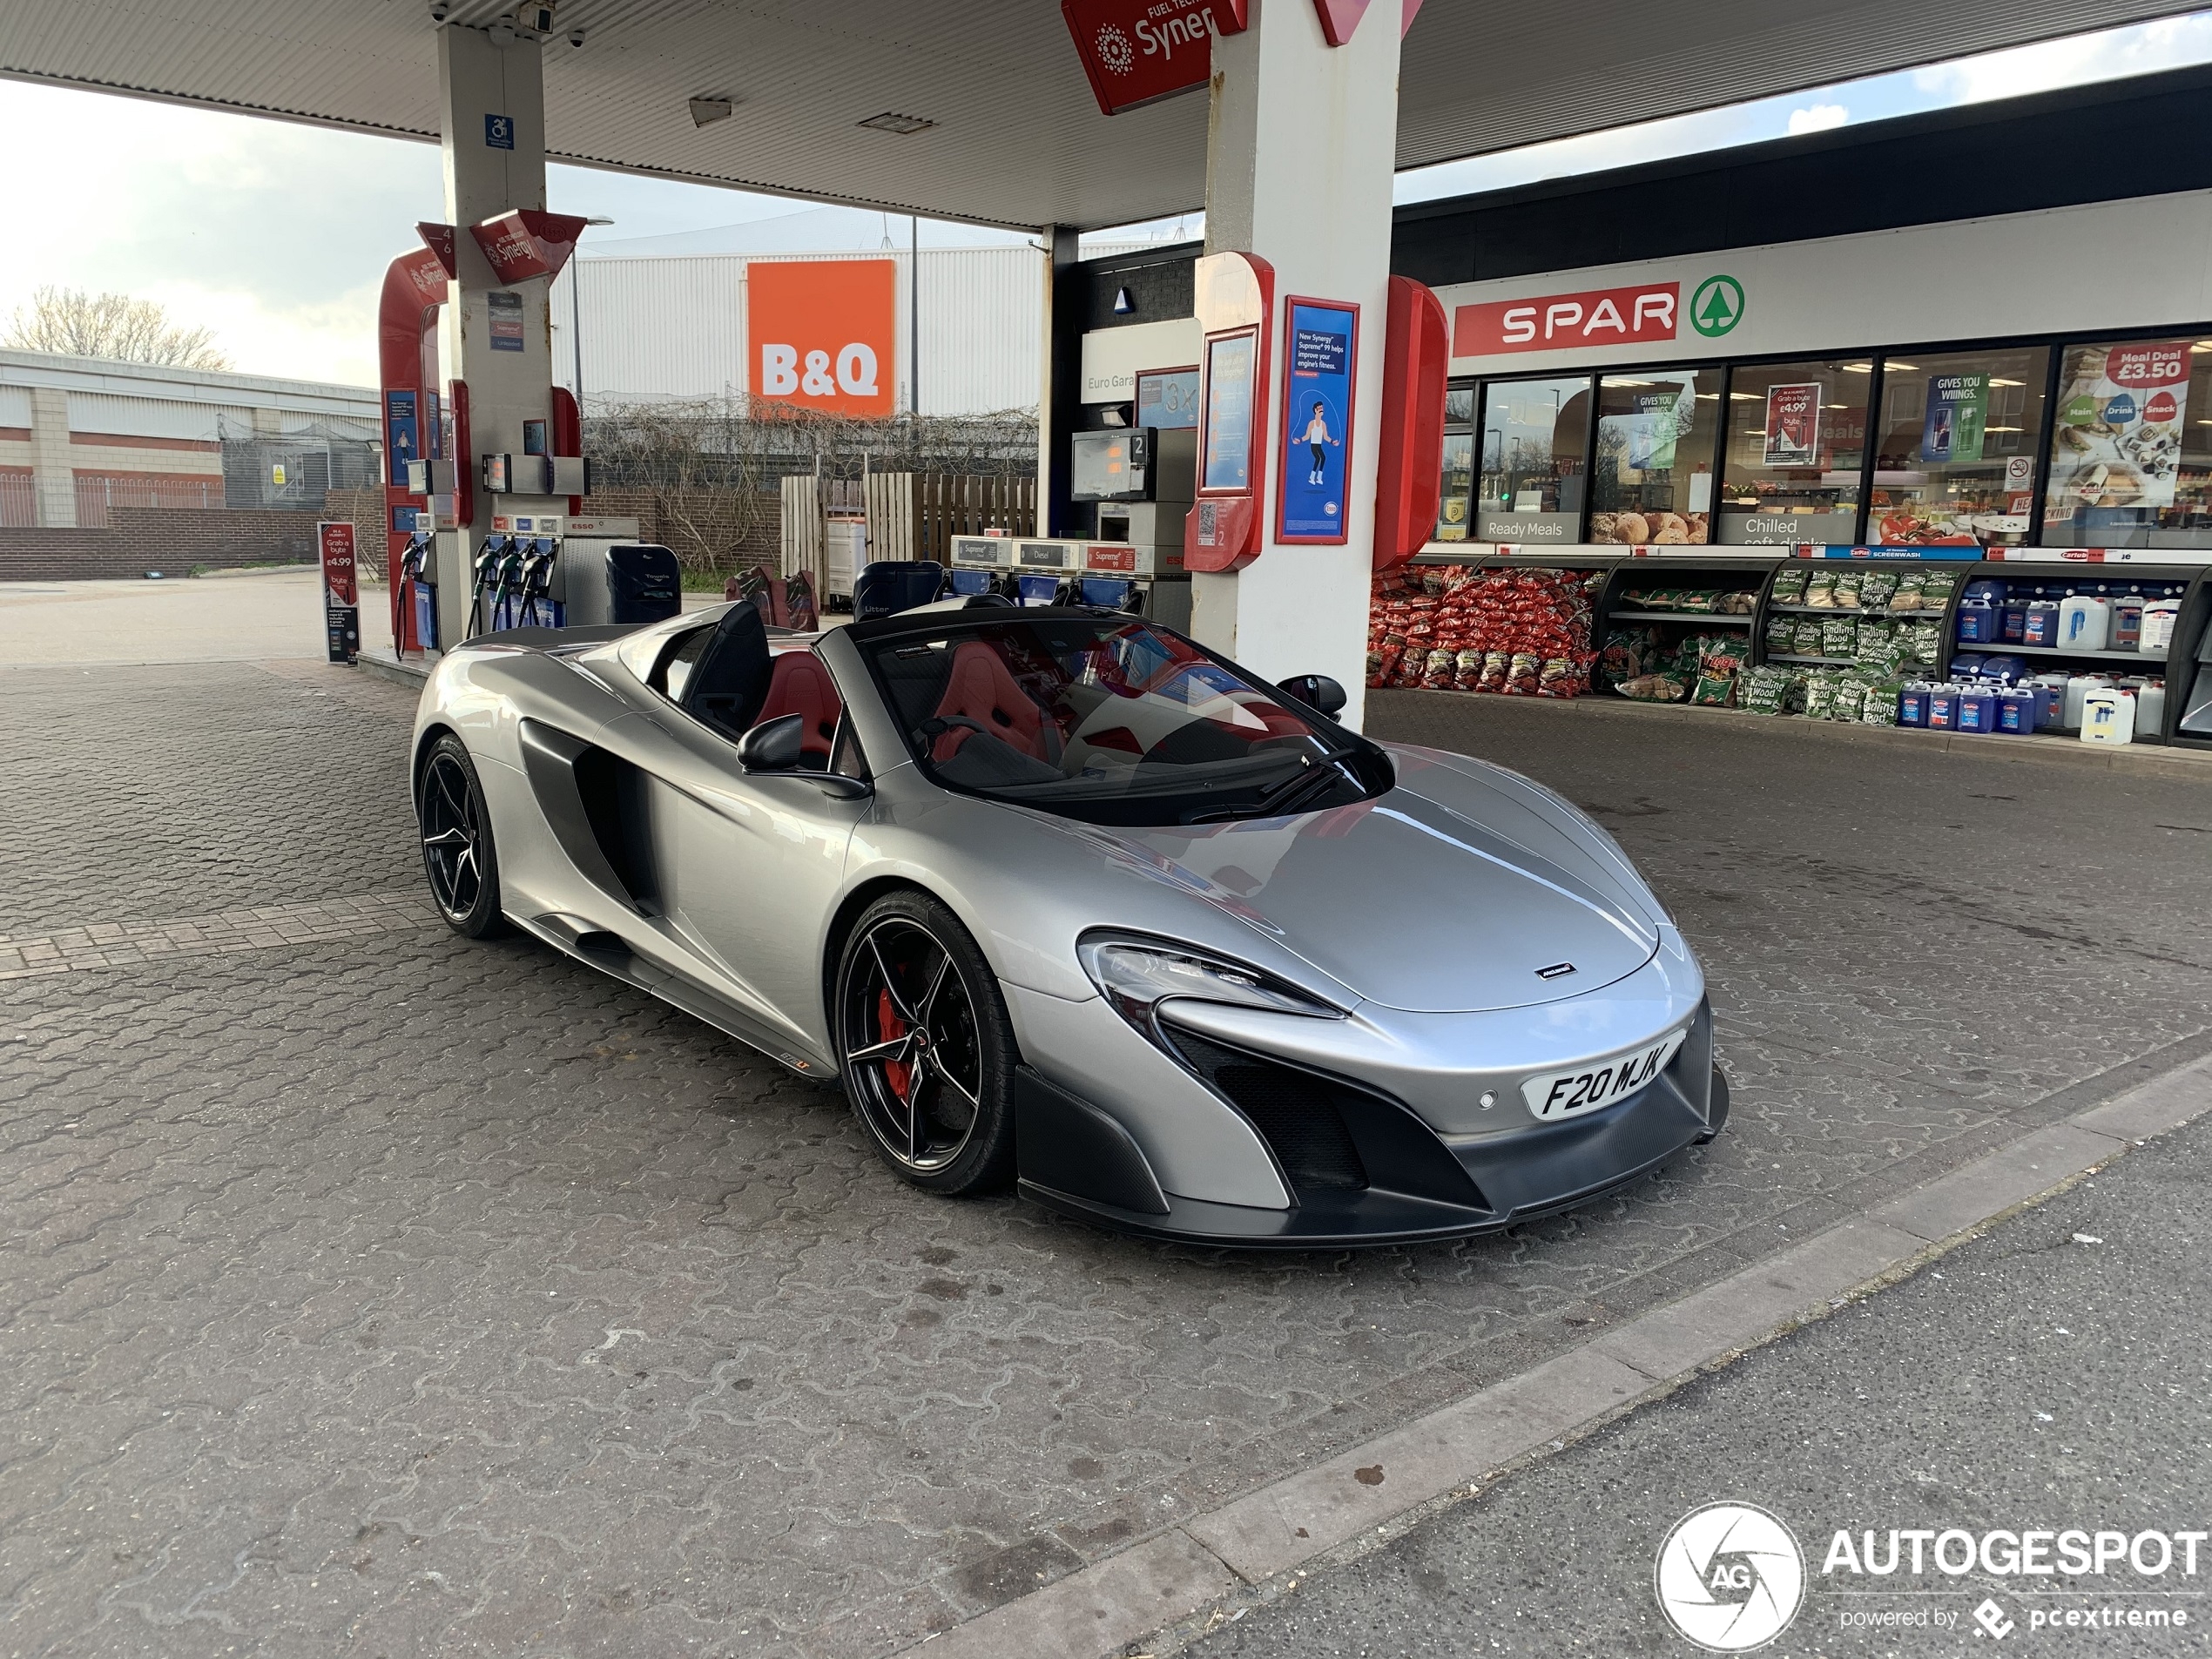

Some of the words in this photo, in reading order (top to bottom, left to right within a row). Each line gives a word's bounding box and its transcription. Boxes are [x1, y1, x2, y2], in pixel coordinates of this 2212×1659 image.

[1148, 2, 1172, 18] FUEL
[442, 229, 452, 239] 4
[443, 244, 452, 254] 6
[496, 239, 536, 265] Synergy
[1502, 292, 1676, 344] SPAR
[1298, 350, 1318, 359] improve
[1331, 345, 1344, 354] helps
[2121, 351, 2150, 362] Meal
[2152, 349, 2181, 361] Deal
[762, 342, 879, 396] B&Q
[1298, 360, 1318, 368] engine's
[1318, 361, 1336, 369] fitness.
[2117, 361, 2182, 380] £3.50
[1088, 377, 1110, 389] Euro
[1111, 374, 1135, 388] Gara
[1938, 377, 1961, 388] GIVES
[1963, 376, 1980, 387] YOU
[1640, 396, 1658, 406] GIVES
[1659, 395, 1672, 405] YOU
[1780, 402, 1806, 413] £4.99
[2070, 407, 2092, 415] Main
[2107, 406, 2134, 415] Drink
[2146, 404, 2175, 414] Snack
[1784, 417, 1800, 426] byte
[1135, 436, 1143, 454] 2
[1488, 523, 1526, 538] Ready
[1527, 523, 1562, 536] Meals
[1745, 518, 1797, 533] Chilled
[1217, 530, 1224, 546] 2
[1035, 550, 1049, 559] Diesel
[327, 557, 352, 566] £4.99
[331, 576, 347, 584] byte
[536, 605, 554, 623] Synergy
[1768, 621, 1794, 633] Kindling
[1797, 624, 1822, 636] Kindling
[1824, 622, 1855, 635] Kindling
[1857, 627, 1890, 638] Kindling
[1769, 630, 1786, 638] Wood
[1826, 632, 1848, 643] Wood
[1860, 637, 1883, 645] Wood
[1710, 656, 1740, 670] Logs
[1750, 677, 1784, 692] Kindling
[1840, 678, 1868, 693] Kindling
[1752, 687, 1776, 698] Wood
[1842, 686, 1861, 698] Wood
[1541, 1068, 1613, 1115] F20
[1610, 1042, 1669, 1096] MJK
